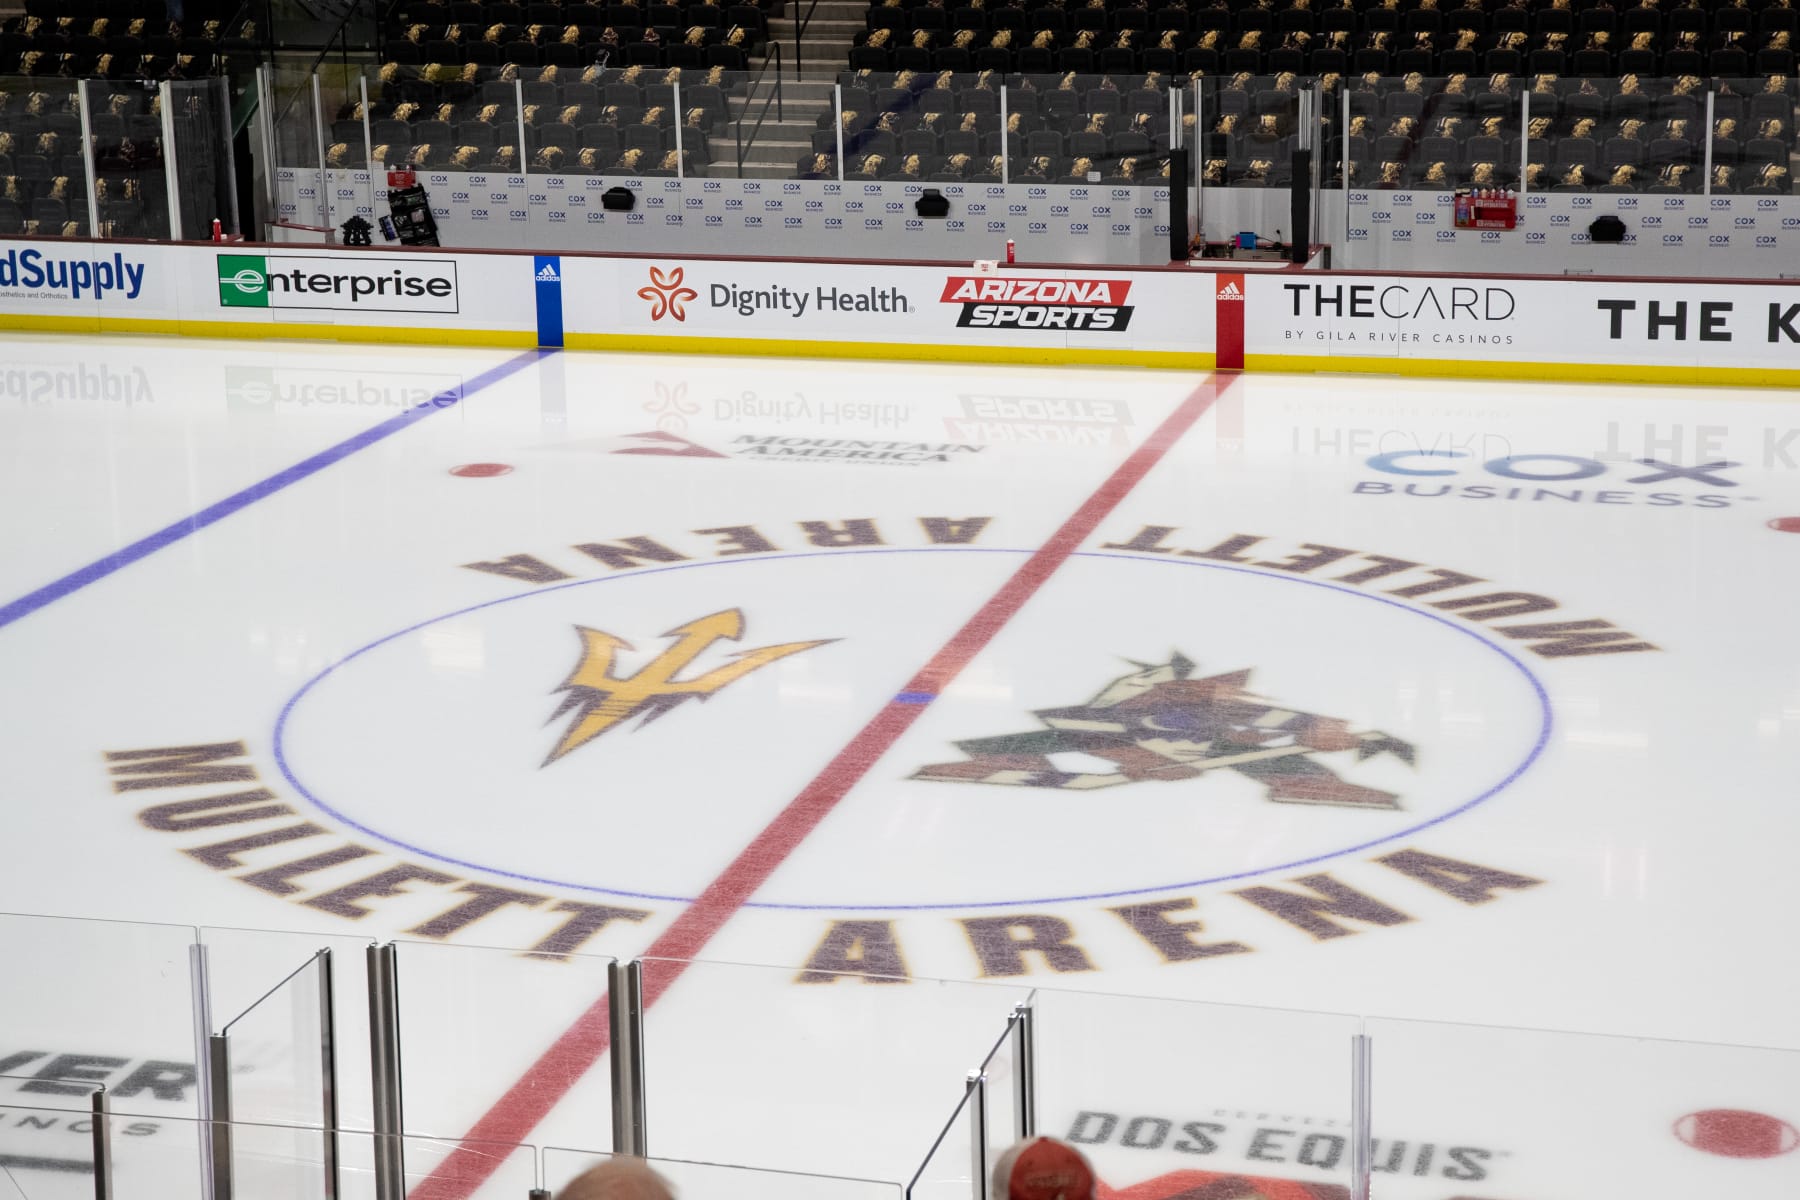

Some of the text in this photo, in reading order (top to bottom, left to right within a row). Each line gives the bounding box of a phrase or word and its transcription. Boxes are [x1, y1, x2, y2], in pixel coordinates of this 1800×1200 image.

[277, 171, 295, 179] COX
[353, 173, 372, 181] COX
[430, 175, 448, 183] COX
[468, 176, 487, 184] COX
[507, 177, 525, 185] COX
[546, 178, 565, 186] COX
[585, 179, 603, 187] COX
[624, 180, 643, 188] COX
[664, 181, 683, 189] COX
[703, 182, 721, 190] COX
[743, 183, 761, 191] COX
[782, 183, 801, 191] COX
[823, 184, 841, 192] COX
[863, 185, 882, 193] COX
[298, 188, 316, 196] COX
[336, 189, 355, 197] COX
[904, 186, 923, 194] COX
[945, 186, 964, 195] COX
[986, 187, 1005, 195] COX
[1027, 188, 1047, 196] COX
[1069, 189, 1089, 197] COX
[1111, 189, 1131, 198] COX
[451, 192, 470, 200] COX
[490, 193, 509, 201] COX
[528, 194, 547, 202] COX
[567, 195, 586, 203] COX
[1349, 193, 1369, 201] COX
[1392, 194, 1413, 202] COX
[646, 197, 665, 205] COX
[685, 198, 704, 206] COX
[724, 199, 743, 207] COX
[764, 200, 783, 208] COX
[1526, 196, 1547, 205] COX
[1571, 197, 1593, 205] COX
[1617, 198, 1639, 206] COX
[1663, 198, 1685, 207] COX
[1710, 199, 1732, 207] COX
[1757, 199, 1779, 208] COX
[279, 205, 297, 213] COX
[804, 201, 823, 209] COX
[844, 201, 864, 209] COX
[885, 202, 904, 210] COX
[967, 203, 987, 212] COX
[1008, 204, 1028, 212] COX
[1050, 205, 1070, 213] COX
[356, 206, 374, 214] COX
[432, 208, 450, 216] COX
[471, 209, 489, 217] COX
[509, 210, 527, 218] COX
[1091, 206, 1112, 214] COX
[1133, 207, 1153, 215] COX
[548, 211, 566, 219] COX
[587, 212, 605, 220] COX
[626, 213, 645, 221] COX
[665, 214, 684, 222] COX
[704, 215, 723, 223] COX
[1371, 211, 1392, 220] COX
[1415, 212, 1436, 221] COX
[1550, 215, 1571, 223] COX
[744, 216, 763, 224] COX
[784, 217, 803, 225] COX
[824, 218, 843, 226] COX
[864, 218, 883, 226] COX
[905, 219, 924, 228] COX
[946, 220, 965, 228] COX
[1641, 216, 1663, 225] COX
[1687, 216, 1709, 225] COX
[1734, 217, 1756, 225] COX
[987, 221, 1006, 229] COX
[1028, 222, 1047, 230] COX
[1069, 223, 1089, 231] COX
[1111, 224, 1131, 232] COX
[1348, 228, 1368, 236] COX
[1391, 229, 1412, 238] COX
[1436, 230, 1457, 239] COX
[1480, 232, 1501, 240] COX
[1525, 232, 1546, 240] COX
[1570, 233, 1591, 241] COX
[1662, 234, 1684, 243] COX
[1708, 235, 1730, 244] COX
[1755, 236, 1777, 244] COX
[0, 249, 145, 300] dSupply
[535, 275, 561, 283] adidas
[228, 268, 453, 303] enterprise
[951, 279, 1112, 303] ARIZONA
[710, 282, 909, 317] Dignity Health
[1216, 293, 1245, 301] adidas
[969, 304, 1118, 329] SPORTS
[1597, 299, 1734, 342] THE
[1285, 330, 1514, 345] BY GILA RIVER CASINOS
[731, 434, 986, 454] MOUNTAIN
[736, 445, 952, 463] AMERICA
[1365, 448, 1744, 489] COX
[1352, 480, 1734, 509] BUSINESS
[459, 516, 994, 585] ARENA
[1097, 523, 1664, 661] MULLET
[103, 739, 1549, 985] MULLET ARENA
[0, 1112, 162, 1137] NOS
[1064, 1110, 1494, 1183] DOS EQUIS
